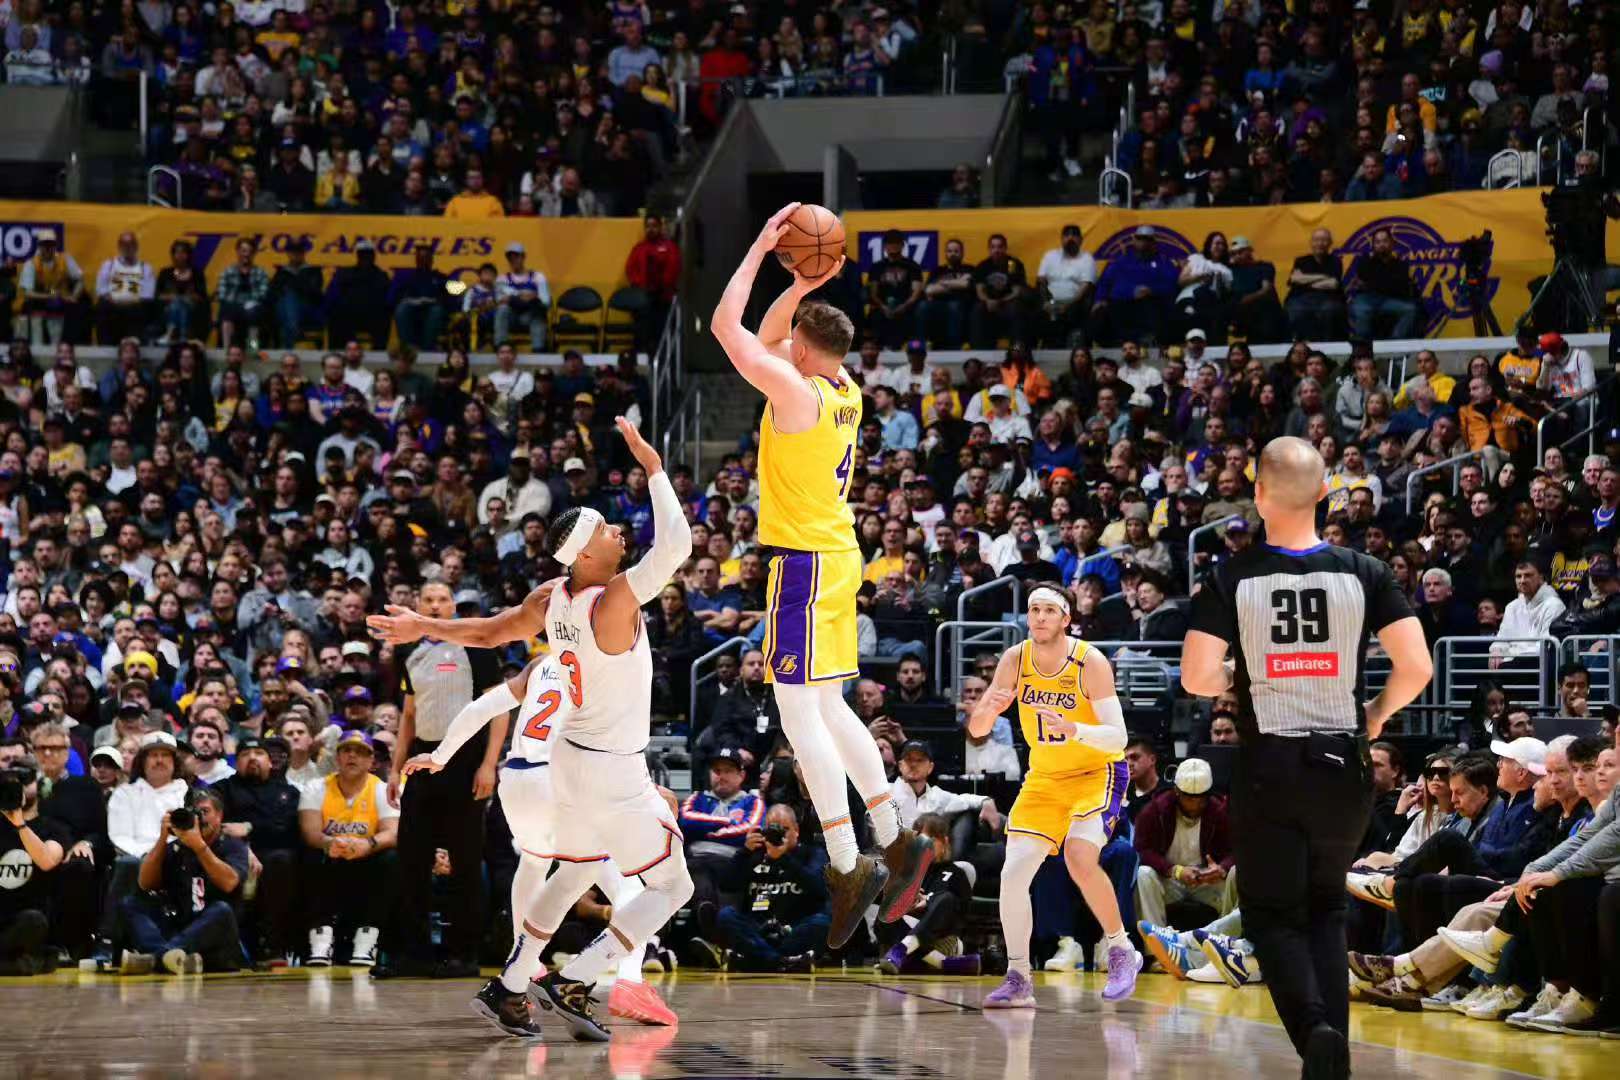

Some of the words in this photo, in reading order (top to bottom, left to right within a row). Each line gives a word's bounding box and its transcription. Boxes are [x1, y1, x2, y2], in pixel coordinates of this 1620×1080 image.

[835, 443, 853, 497] 4
[554, 621, 581, 645] HART
[1271, 588, 1330, 644] 39
[559, 650, 583, 709] 3
[1272, 657, 1333, 672] Emirates
[522, 689, 562, 742] 2
[1021, 683, 1077, 710] LAKERS
